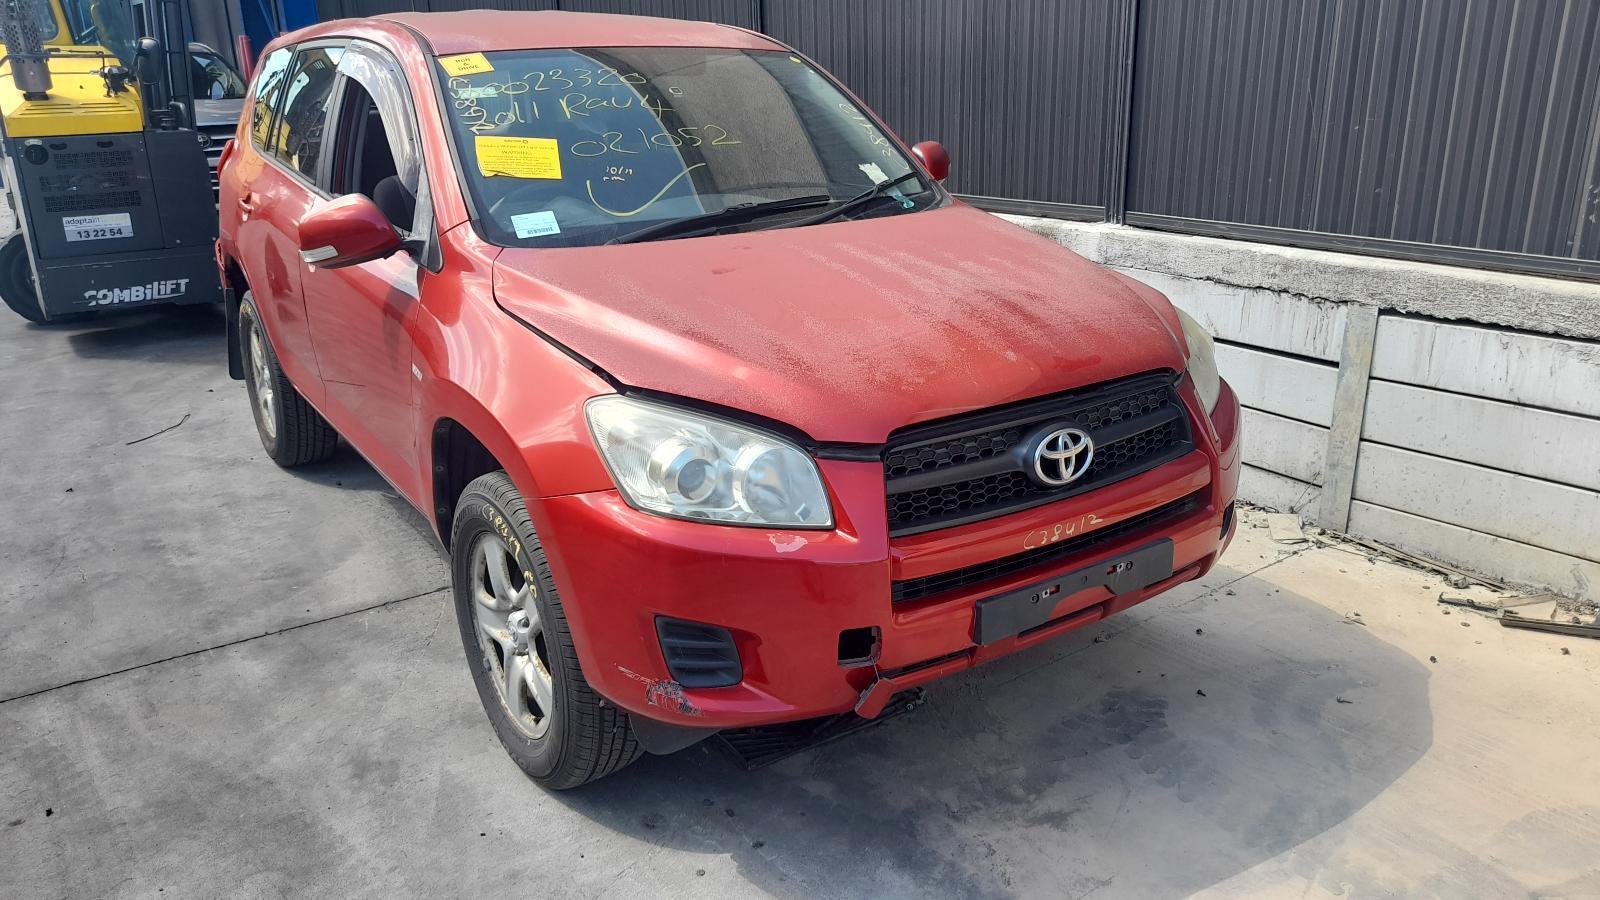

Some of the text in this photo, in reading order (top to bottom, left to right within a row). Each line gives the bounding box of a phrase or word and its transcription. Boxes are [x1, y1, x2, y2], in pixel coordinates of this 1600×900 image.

[77, 228, 123, 239] 13 22 54
[1023, 514, 1104, 550] C38412
